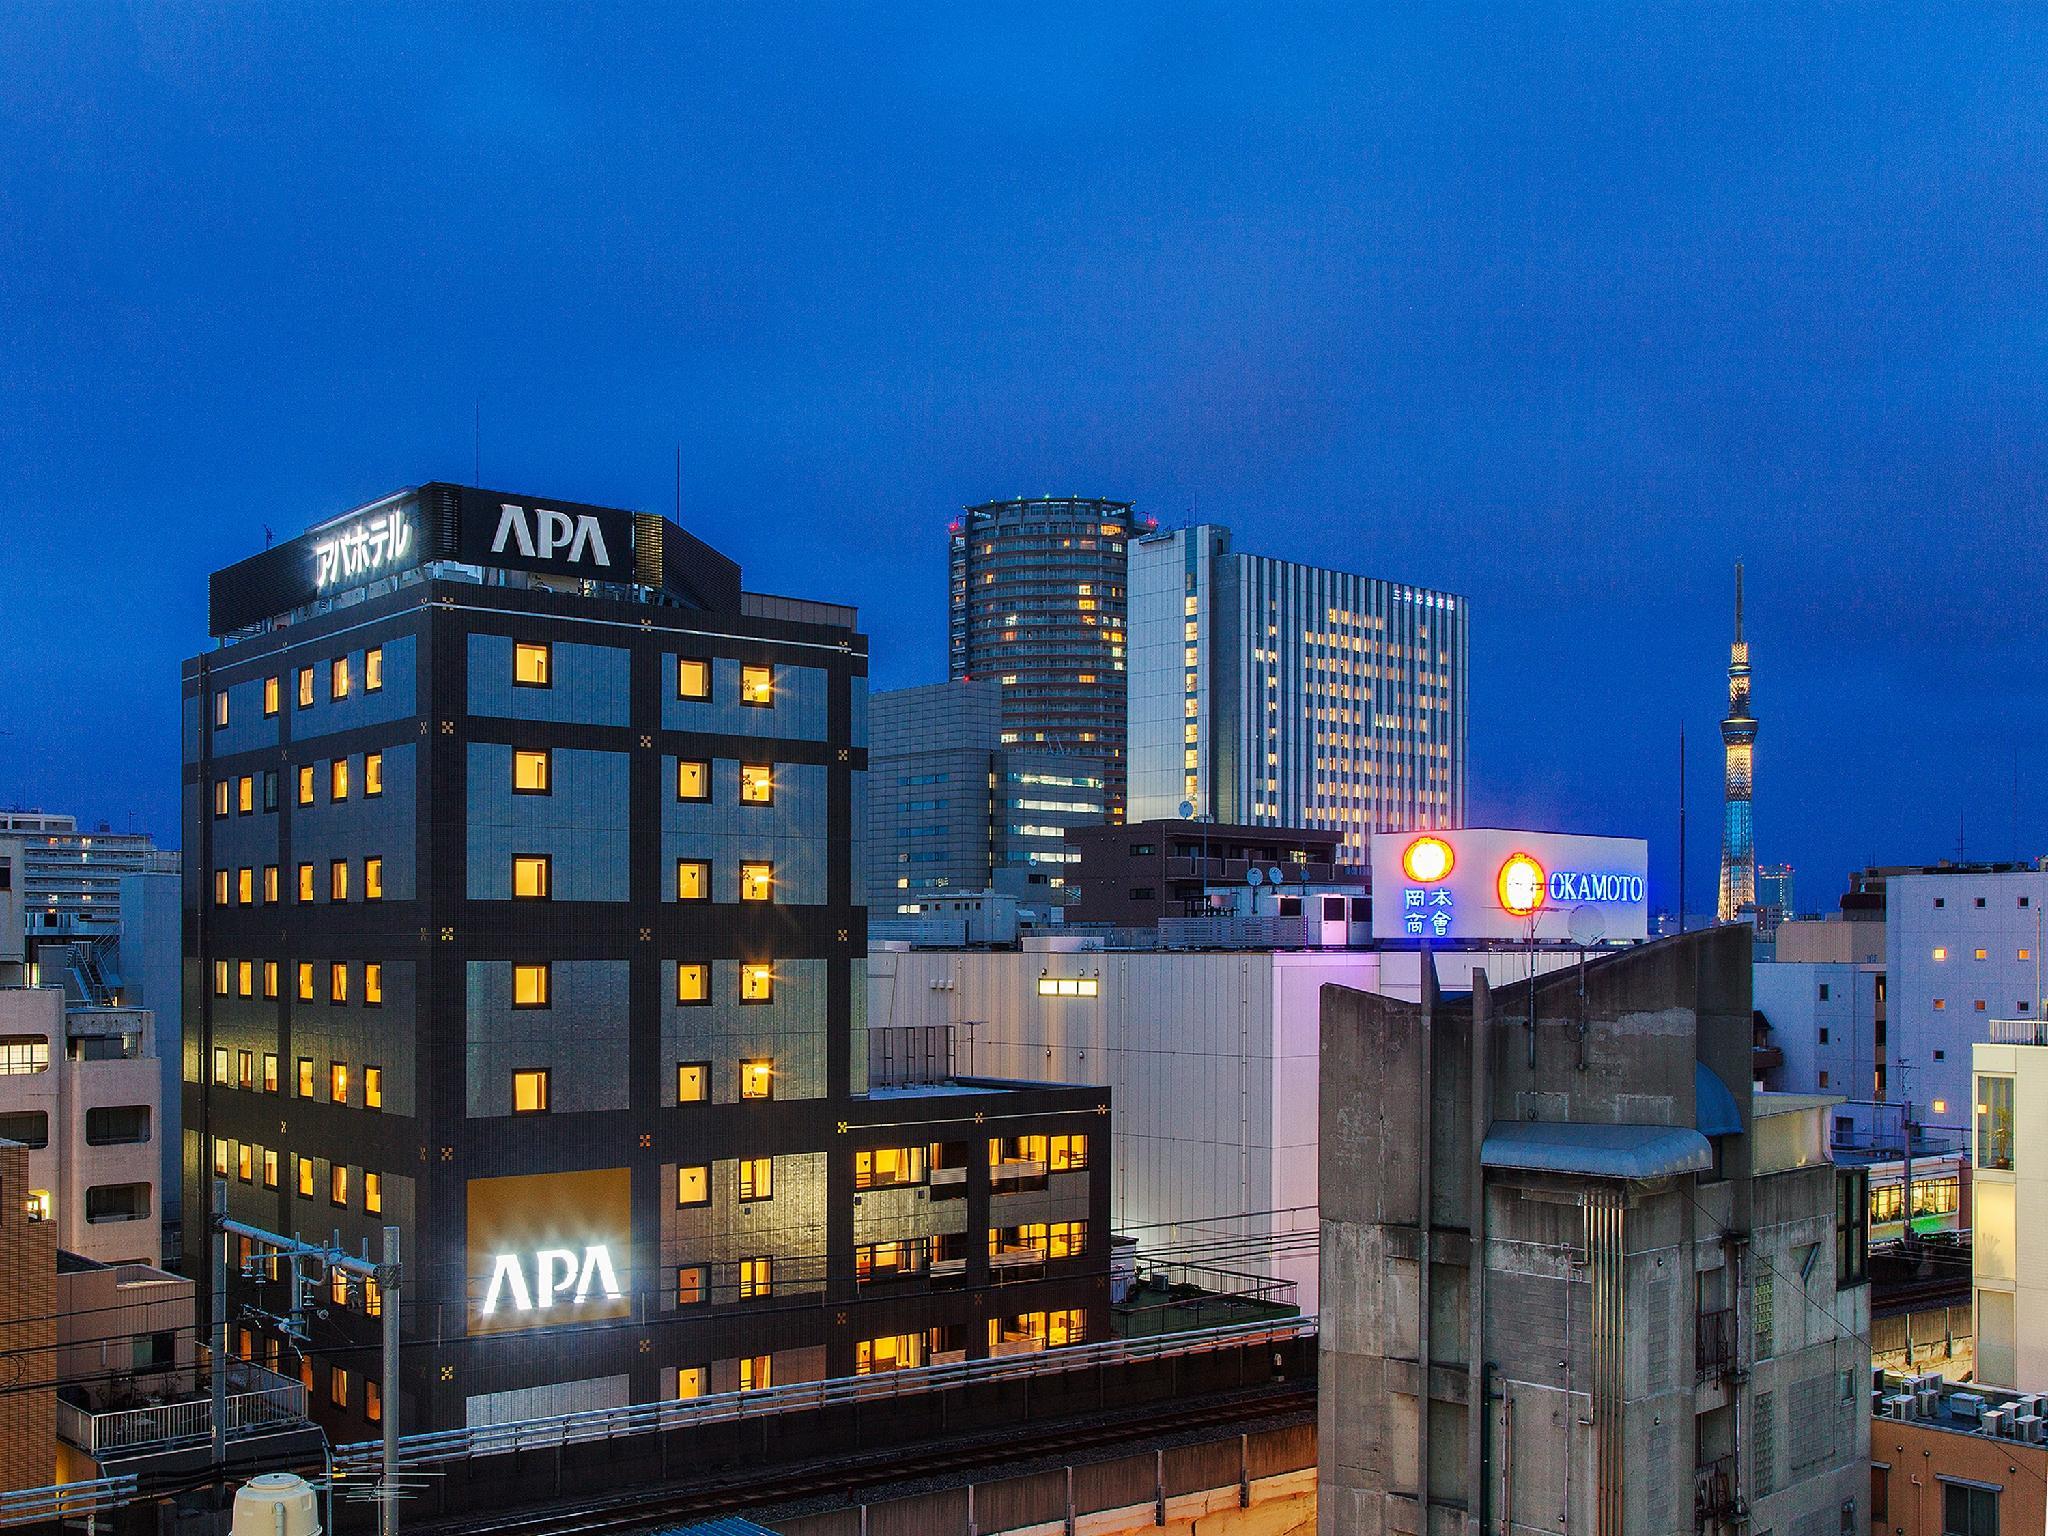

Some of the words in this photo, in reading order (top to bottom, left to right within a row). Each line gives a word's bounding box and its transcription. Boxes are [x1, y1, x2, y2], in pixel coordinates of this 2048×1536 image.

[316, 509, 413, 588] アパホテル
[491, 504, 611, 567] APA
[1404, 887, 1453, 910] 岡本
[1549, 872, 1644, 902] OKAMOTO
[482, 1244, 624, 1315] APA
